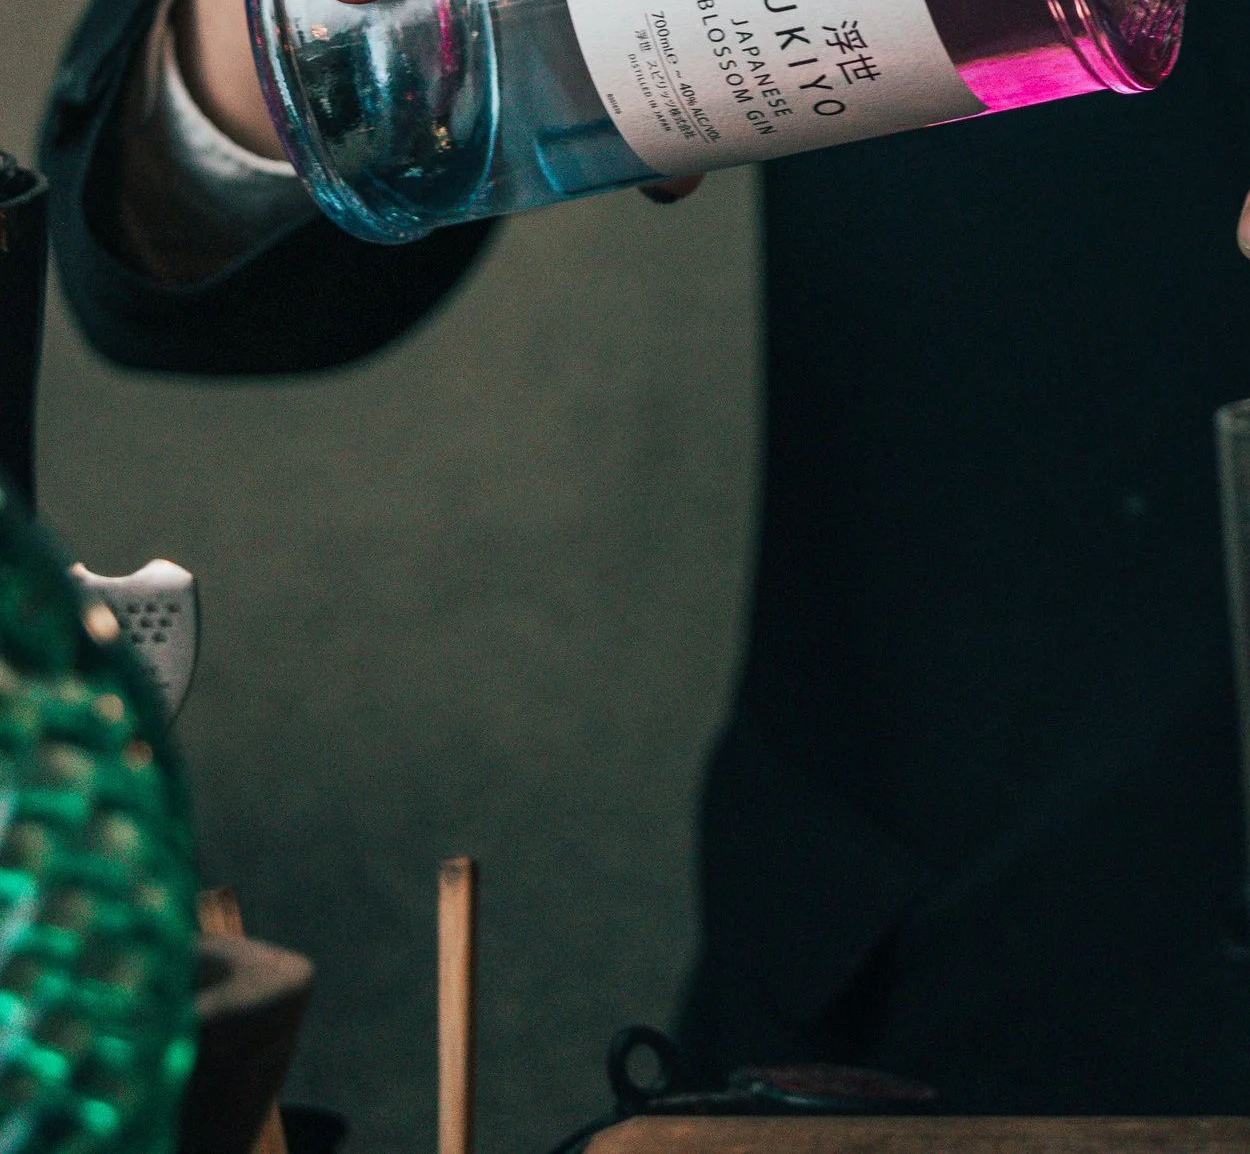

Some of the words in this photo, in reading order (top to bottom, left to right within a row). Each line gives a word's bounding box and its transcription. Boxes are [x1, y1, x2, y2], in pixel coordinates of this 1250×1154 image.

[731, 19, 793, 117] JAPANESE
[822, 20, 881, 85] 浮世
[628, 53, 651, 98] DISTILLED
[649, 99, 658, 109] IN
[654, 110, 672, 133] JAPAN
[679, 82, 698, 106] 40%
[691, 107, 722, 143] ALC/VOL
[746, 110, 776, 136] GIN
